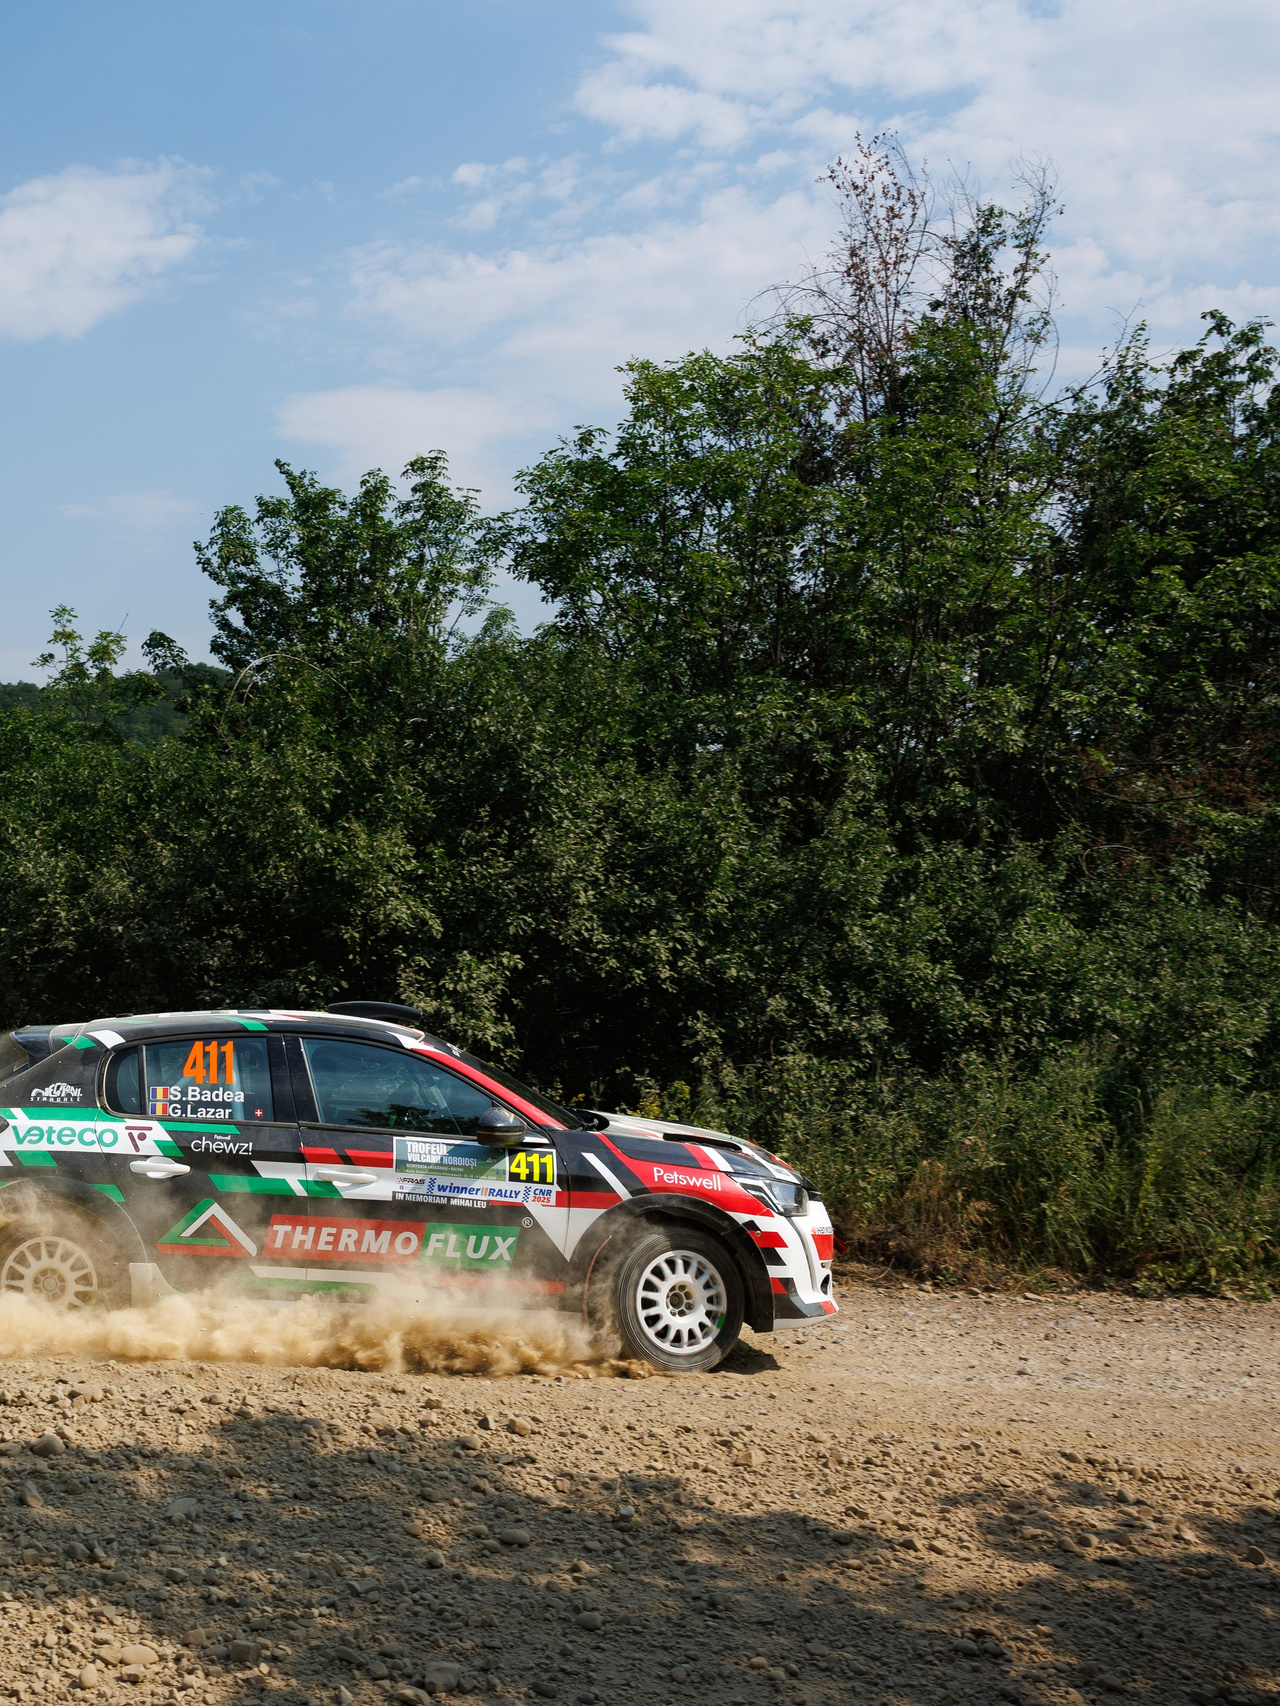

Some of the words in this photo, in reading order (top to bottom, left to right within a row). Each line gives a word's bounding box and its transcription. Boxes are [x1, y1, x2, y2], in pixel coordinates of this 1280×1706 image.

[183, 1040, 234, 1084] 411
[169, 1086, 245, 1103] S.Badea
[168, 1103, 232, 1119] G.Lazar
[191, 1136, 253, 1155] chewz!
[406, 1141, 449, 1156] TROFEUL
[510, 1152, 553, 1183] 411
[653, 1167, 722, 1192] Petswell
[437, 1182, 481, 1196] winner
[488, 1187, 521, 1199] RALLY
[533, 1188, 552, 1197] CNR
[395, 1192, 404, 1200] IN
[405, 1194, 448, 1204] MEMORIAM
[450, 1198, 473, 1207] MIHAI
[473, 1201, 487, 1209] LEU
[532, 1195, 551, 1204] 2025
